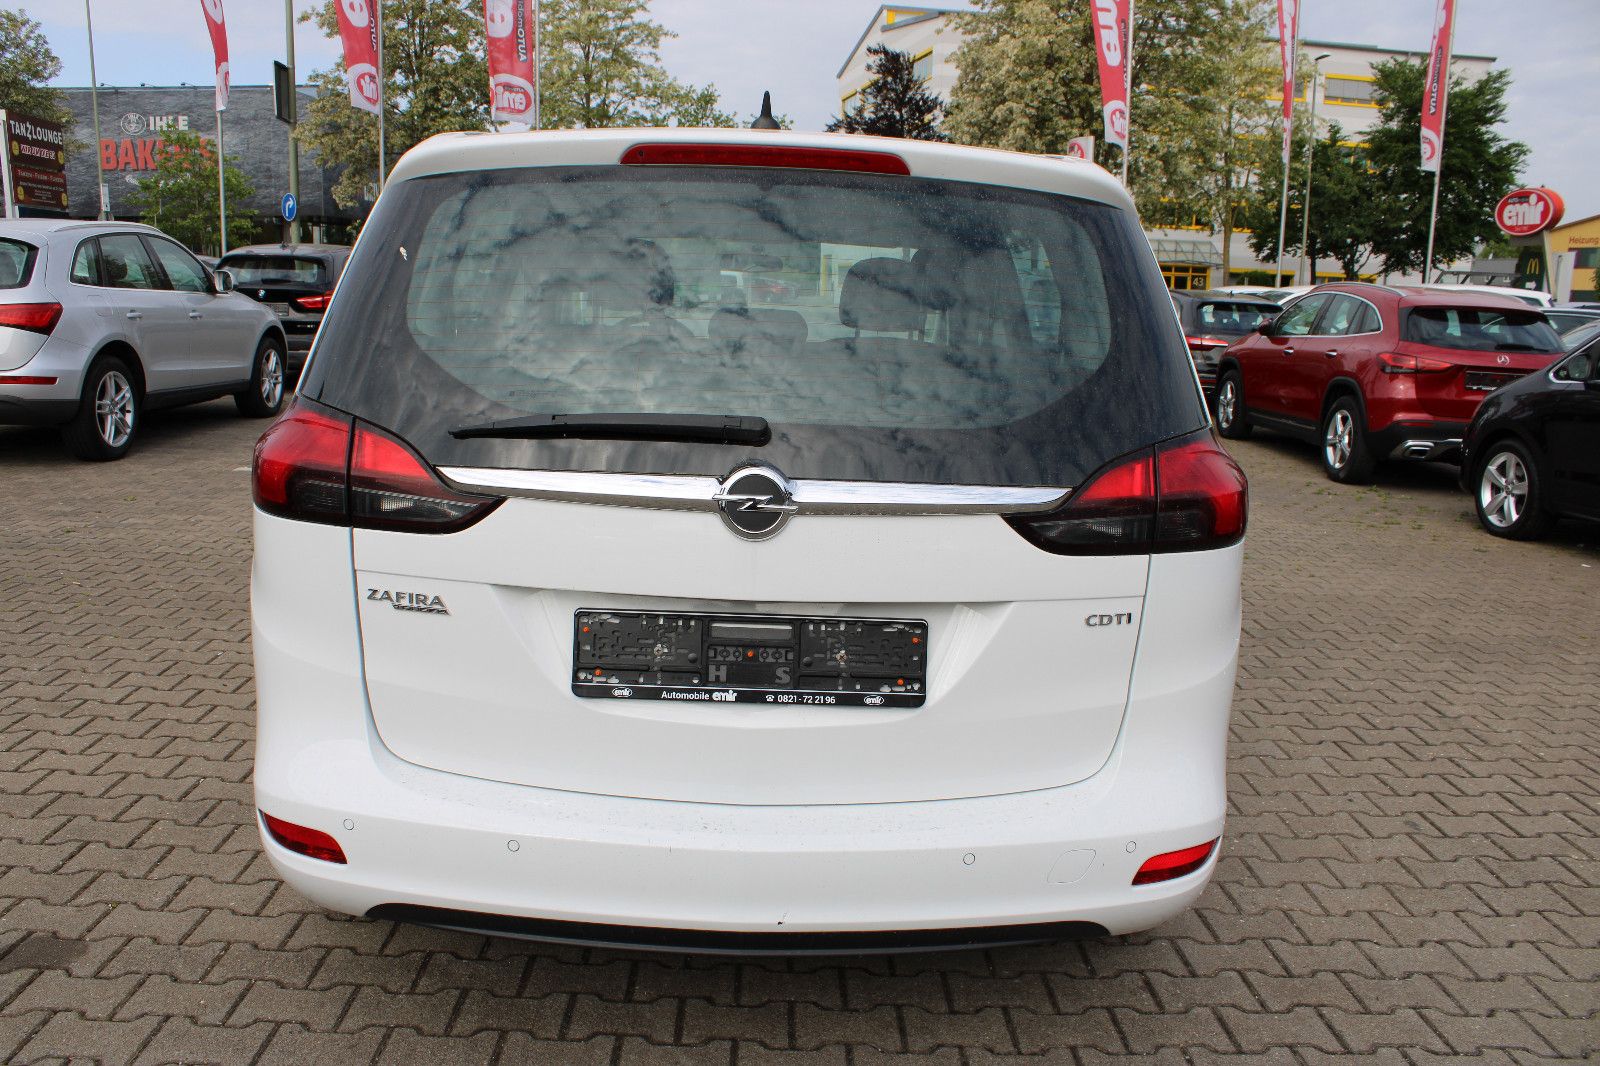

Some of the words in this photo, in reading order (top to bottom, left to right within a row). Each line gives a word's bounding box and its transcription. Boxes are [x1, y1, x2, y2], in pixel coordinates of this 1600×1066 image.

[149, 115, 189, 131] IHLE
[9, 119, 63, 145] TANZLOUNGE
[1503, 193, 1545, 226] emir
[1569, 236, 1600, 246] Heizung
[1193, 277, 1204, 287] 43
[367, 588, 445, 608] ZAFIRA
[1085, 613, 1132, 627] CDTI
[661, 690, 710, 700] Automobile
[712, 689, 738, 702] emir
[777, 694, 797, 703] 0821
